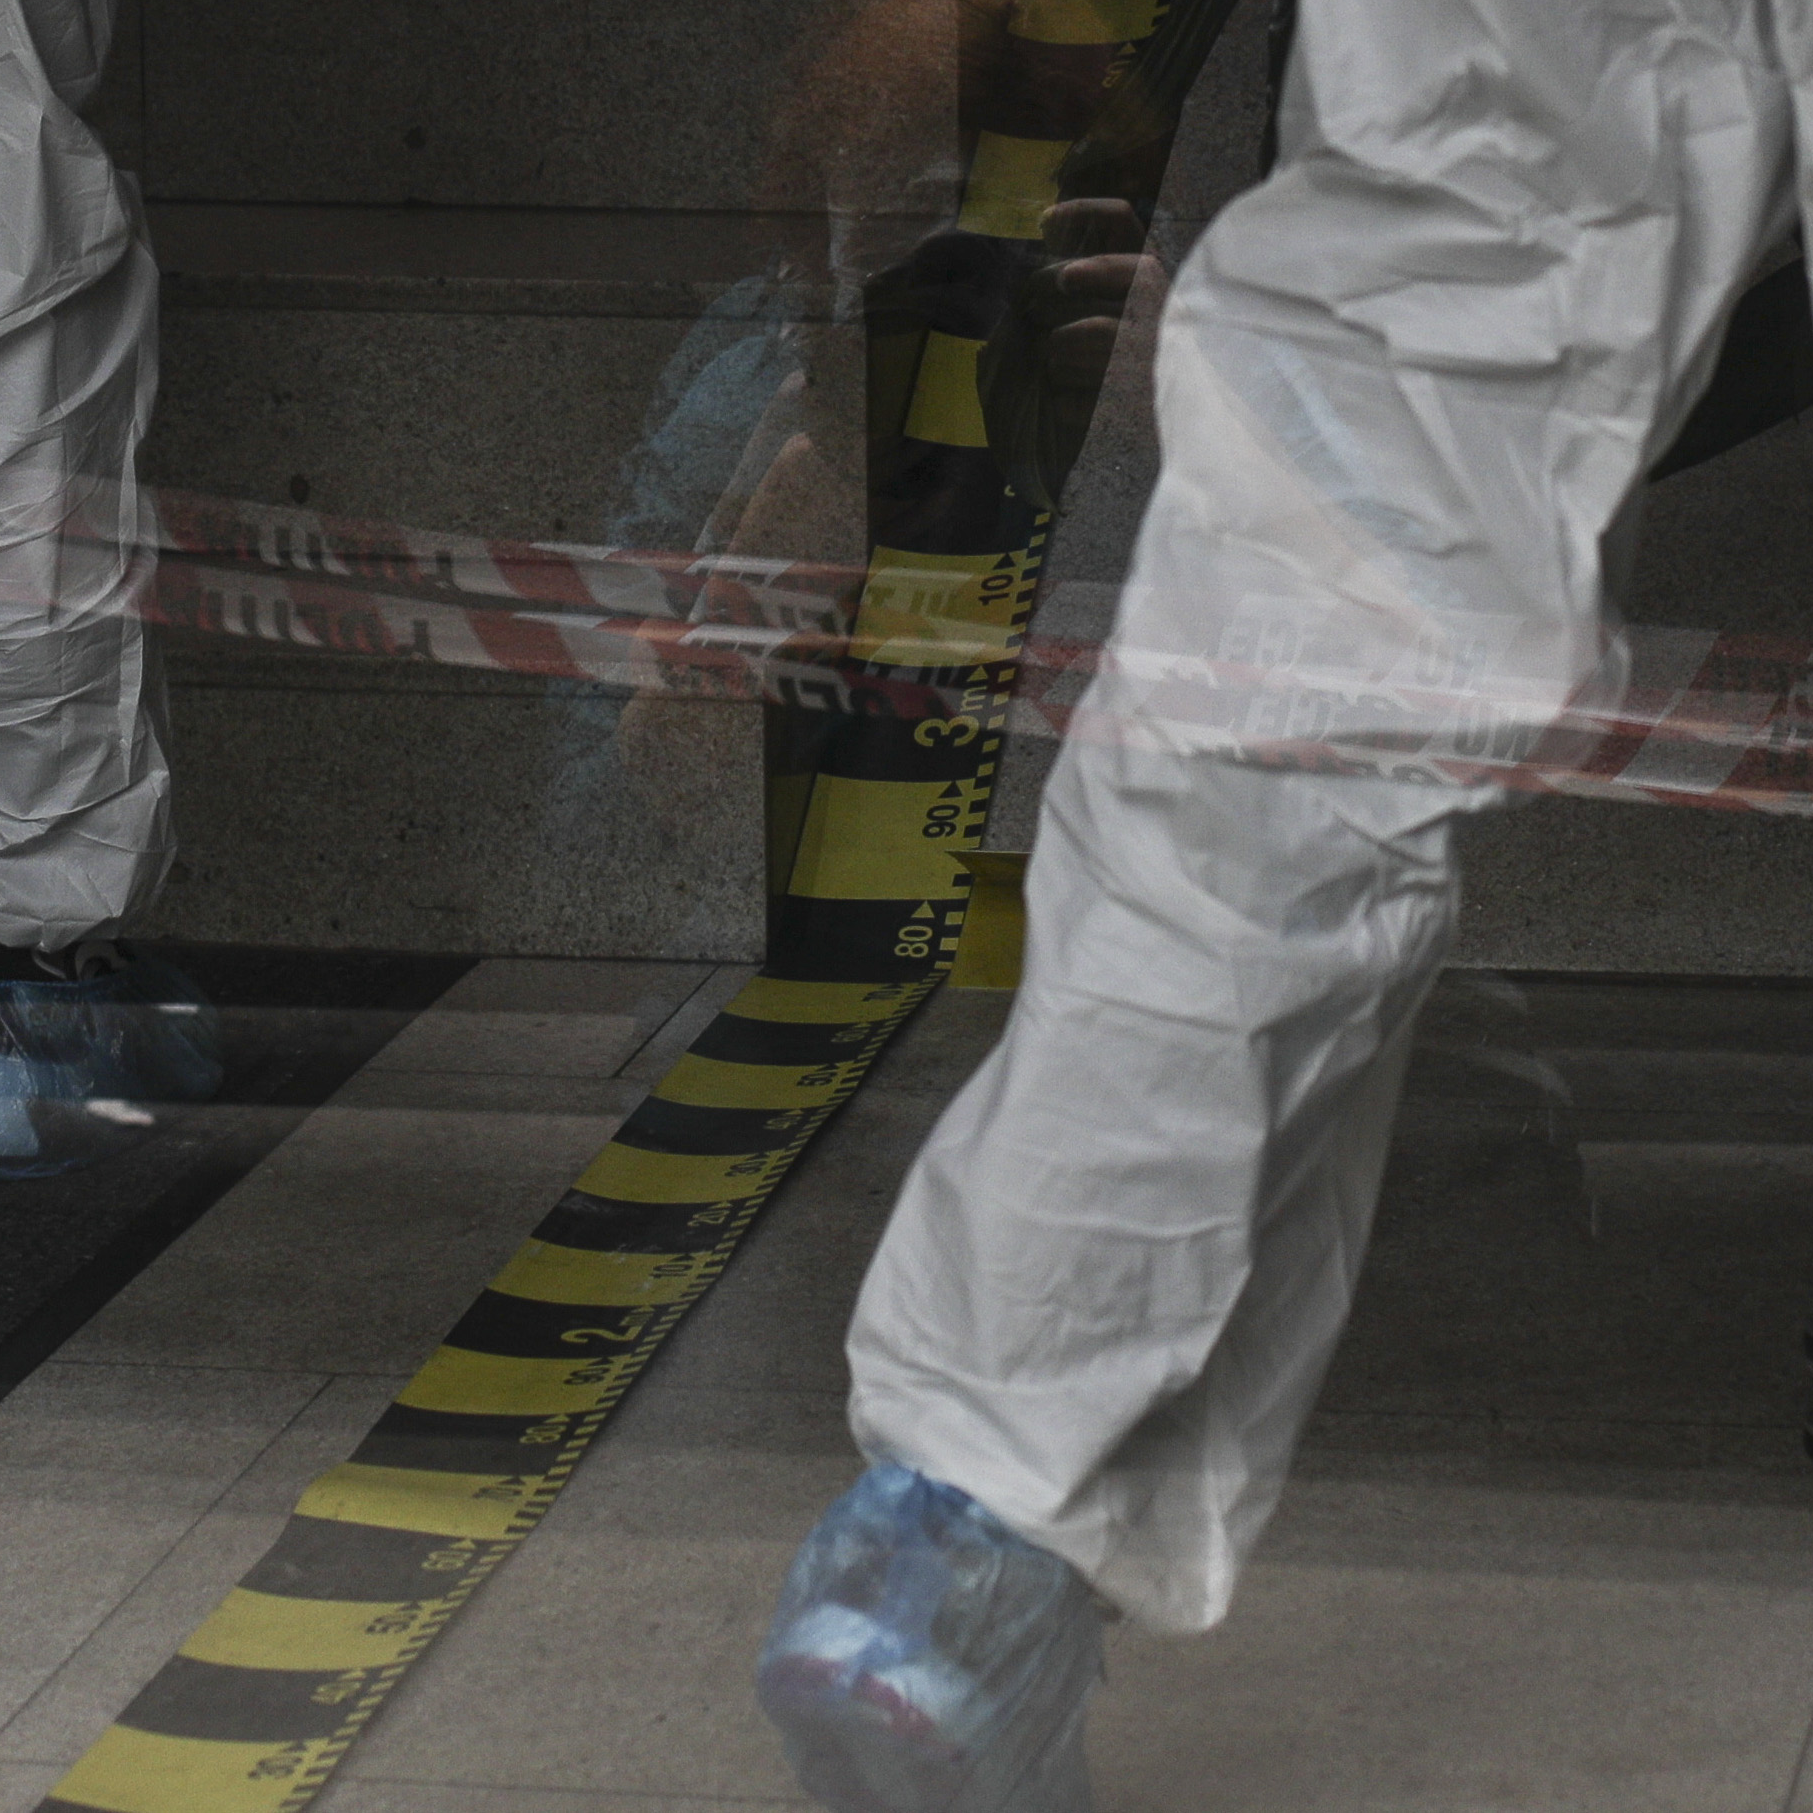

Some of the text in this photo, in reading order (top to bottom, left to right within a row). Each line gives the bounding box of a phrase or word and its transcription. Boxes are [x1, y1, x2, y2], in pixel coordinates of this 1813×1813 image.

[978, 573, 1014, 606] 10
[913, 683, 990, 748] 3m
[922, 804, 962, 839] 90
[893, 924, 935, 959] 80
[687, 1208, 732, 1229] 20
[649, 1263, 694, 1279] 10
[562, 1366, 611, 1386] 90
[517, 1423, 568, 1444] 80
